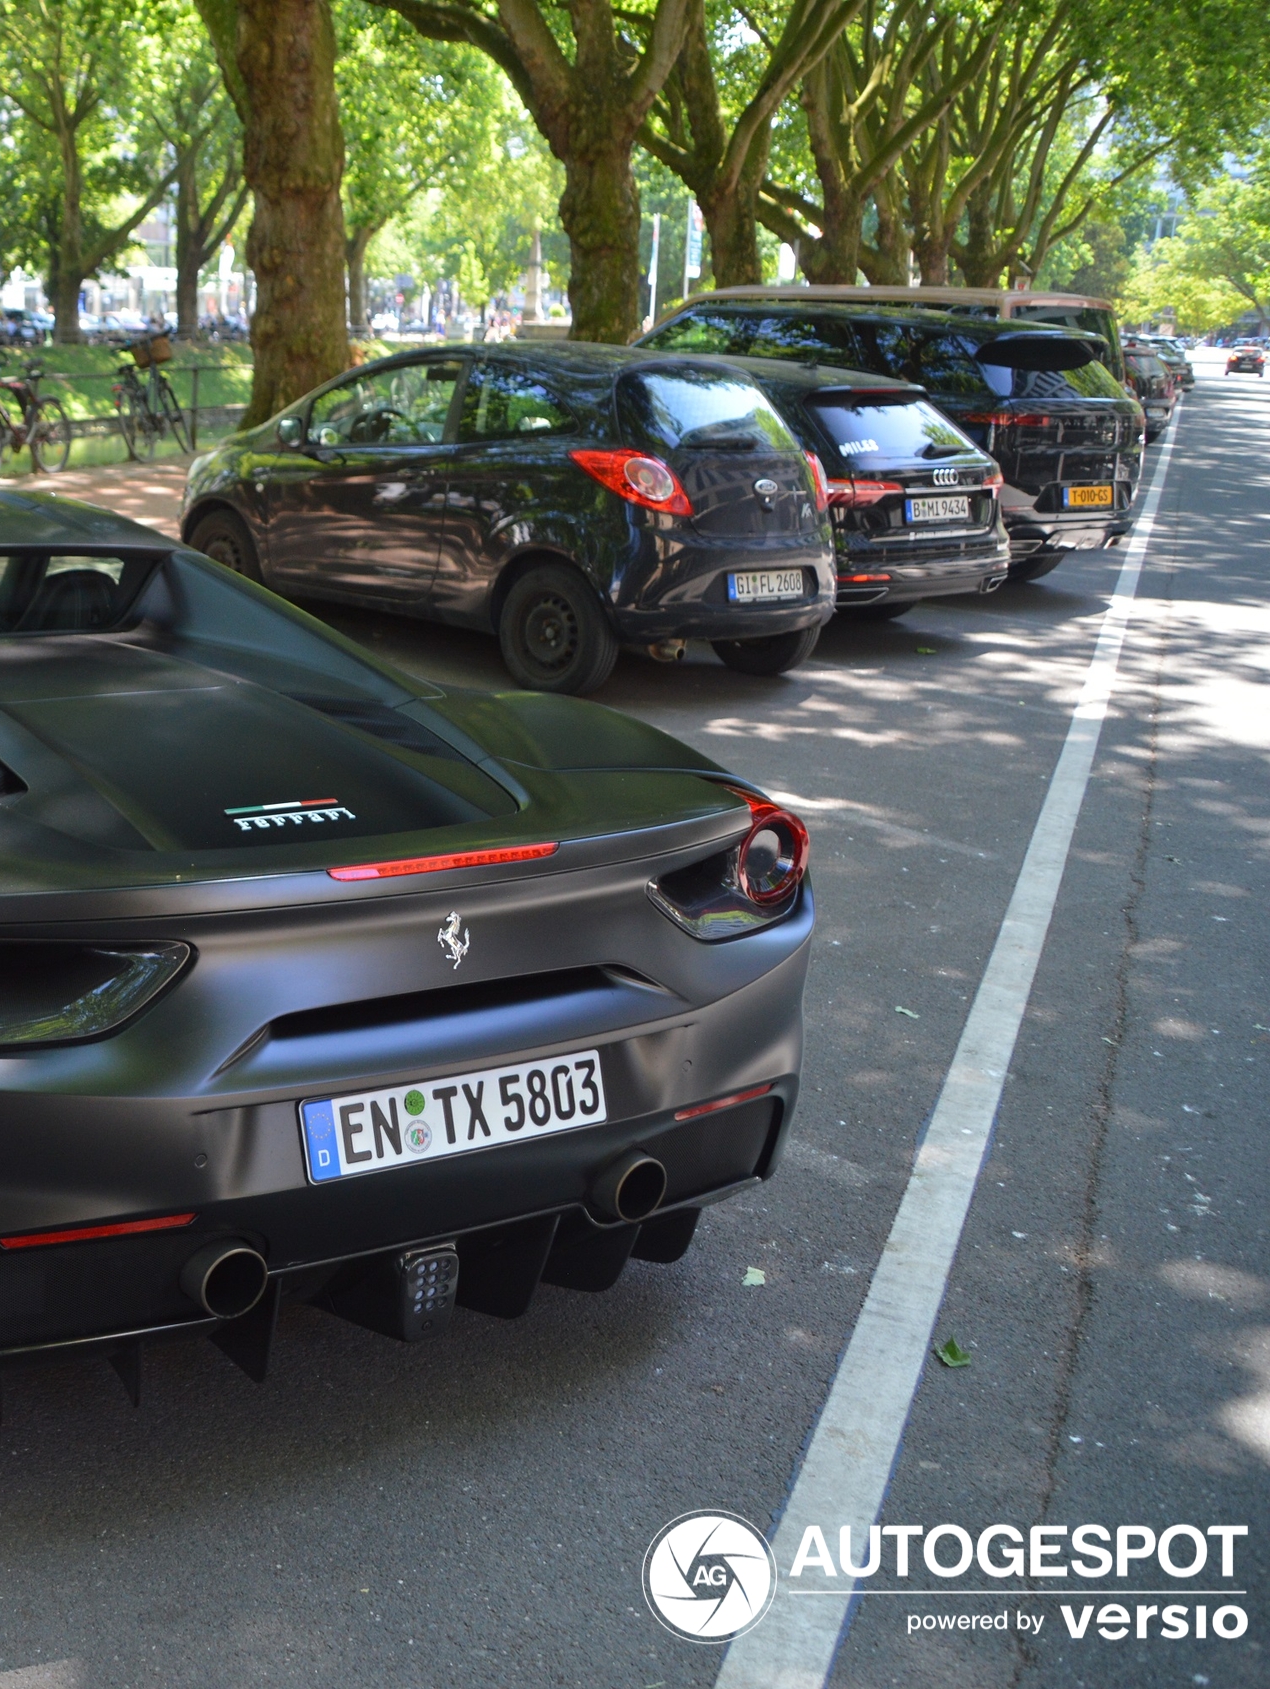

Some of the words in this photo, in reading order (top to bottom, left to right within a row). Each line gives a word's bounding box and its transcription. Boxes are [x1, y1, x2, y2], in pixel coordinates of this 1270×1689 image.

[838, 439, 879, 457] MILES
[1072, 488, 1108, 503] T-010-GS
[913, 501, 921, 518] B
[927, 500, 940, 517] MI
[941, 499, 967, 516] 9434
[736, 575, 751, 595] GI
[760, 574, 775, 593] FL
[776, 572, 802, 592] 2608
[339, 1097, 403, 1164] EN
[432, 1081, 491, 1145] TX
[498, 1059, 600, 1133] 5803
[318, 1149, 331, 1167] D
